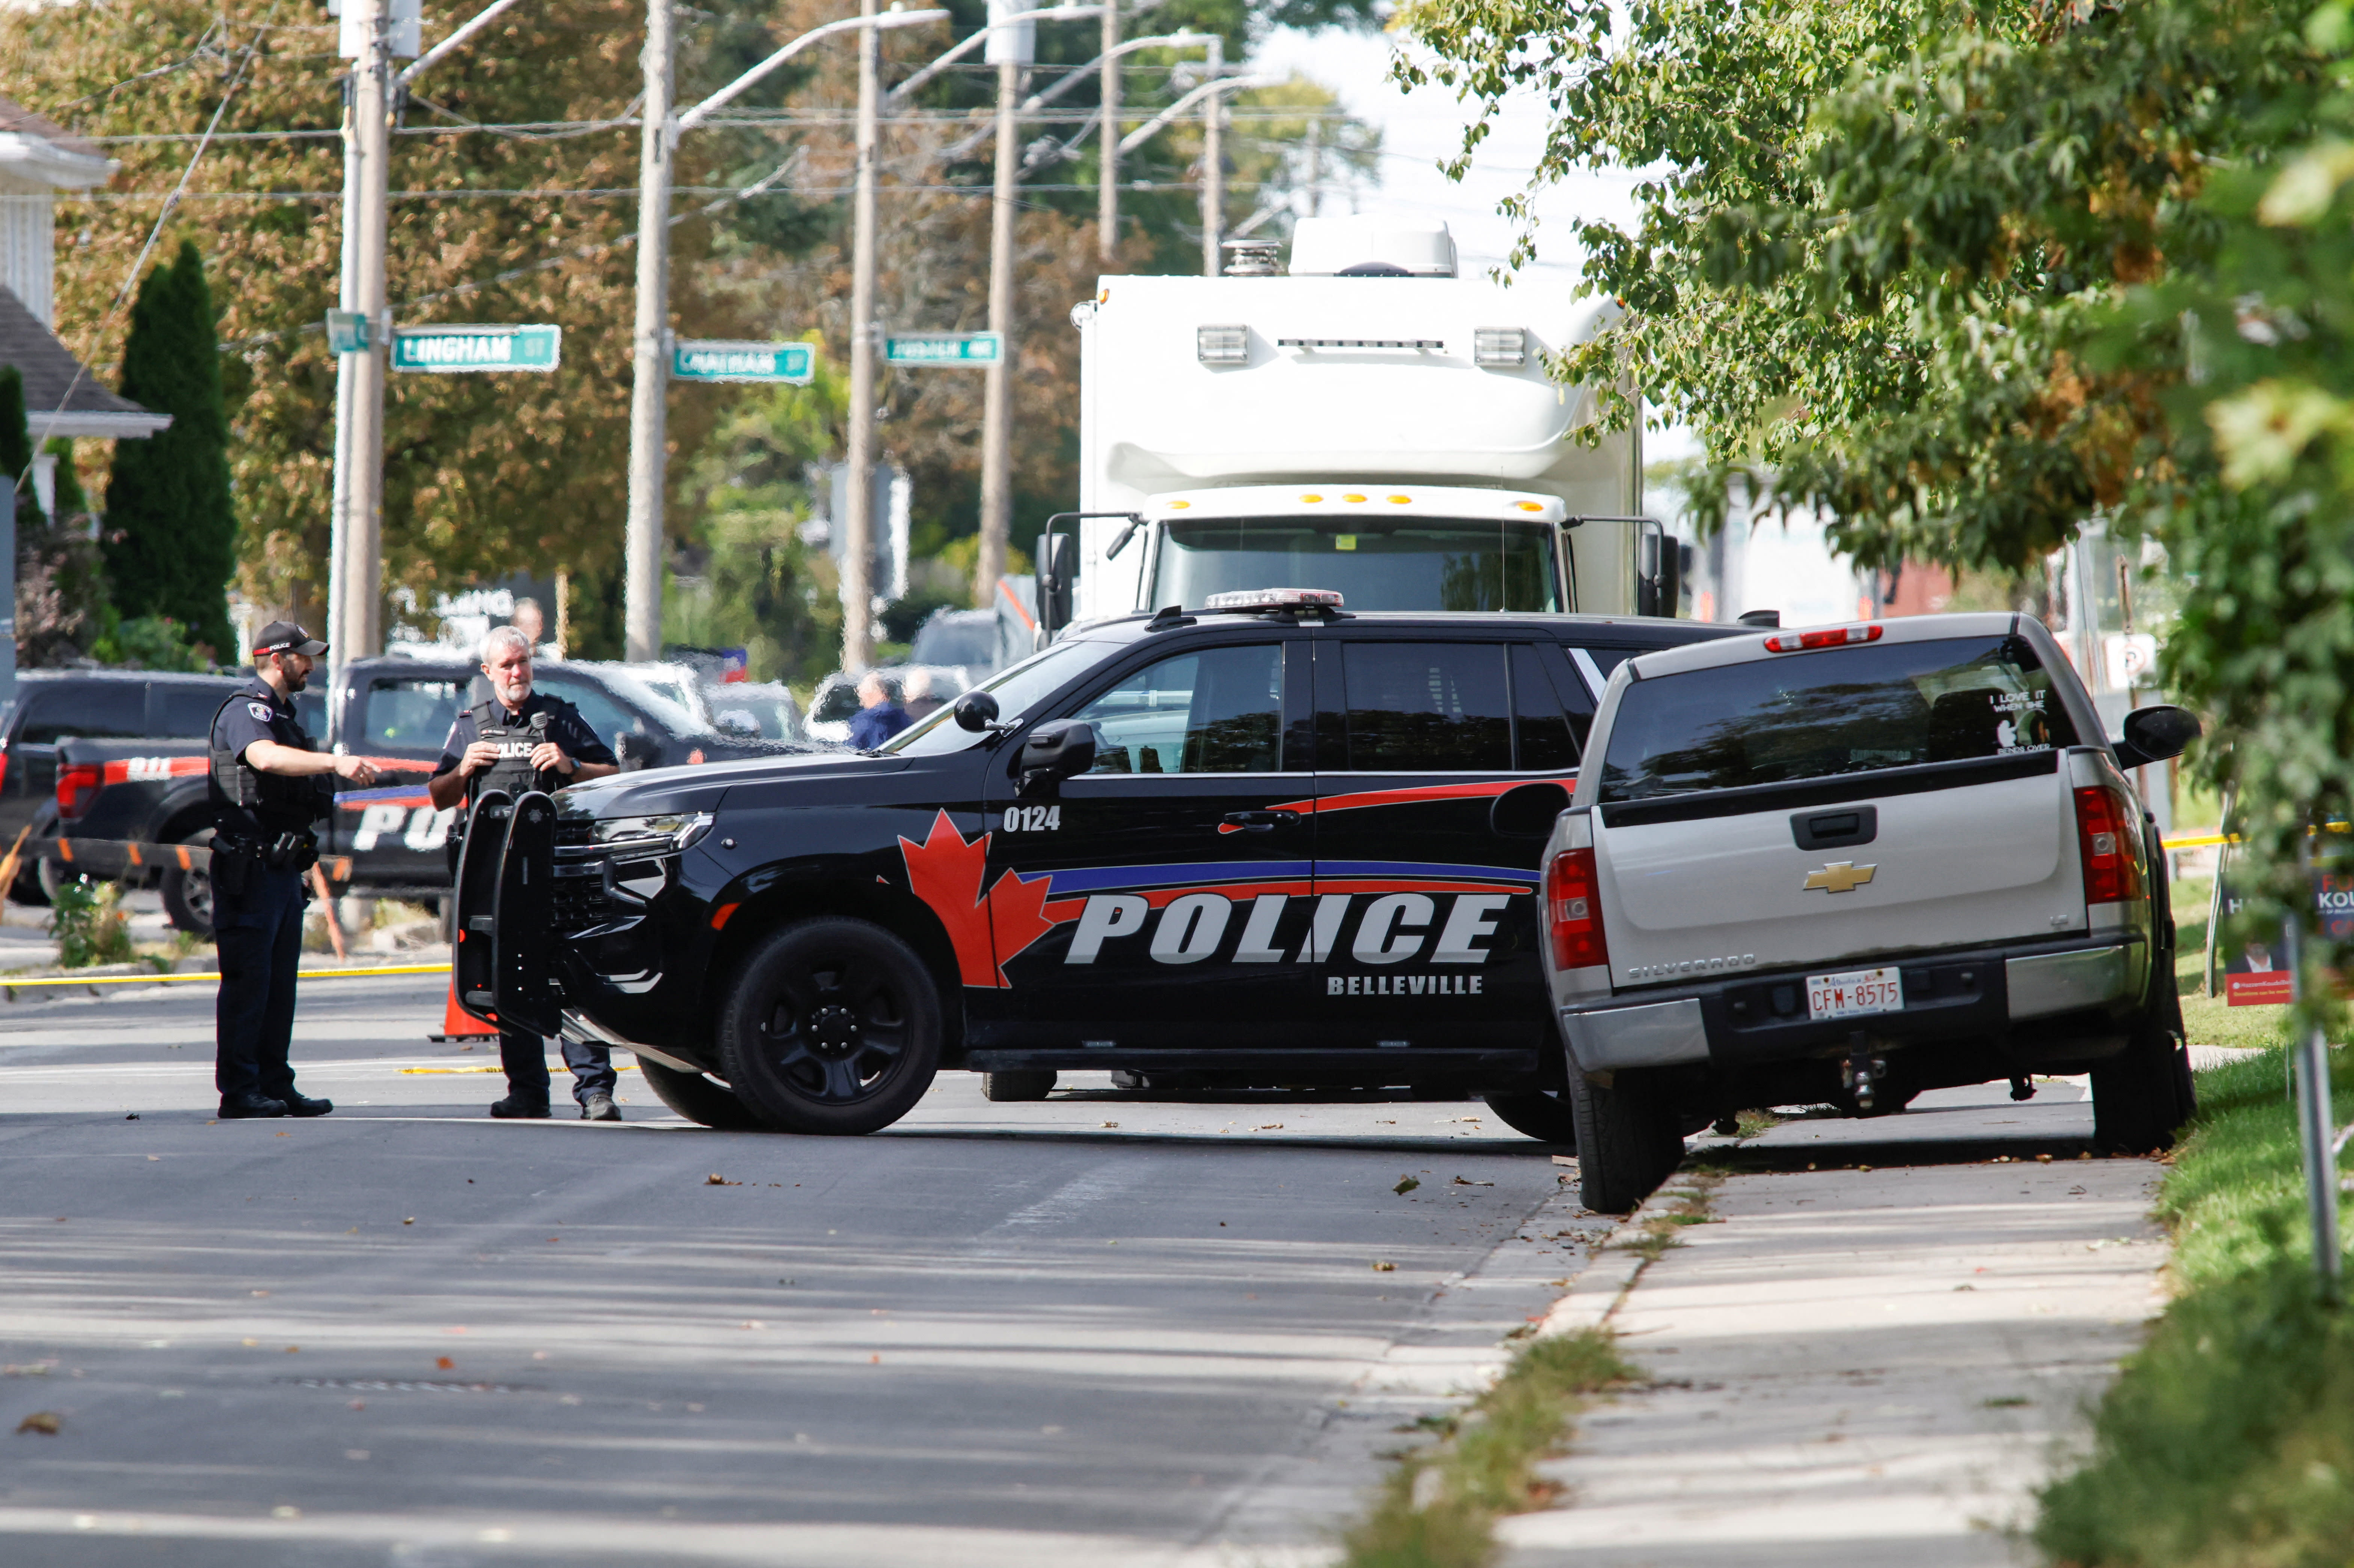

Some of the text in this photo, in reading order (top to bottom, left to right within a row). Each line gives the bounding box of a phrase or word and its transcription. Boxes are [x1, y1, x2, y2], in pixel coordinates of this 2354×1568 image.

[403, 336, 511, 362] LINGHAM
[269, 642, 291, 651] POLICE
[1989, 690, 2046, 704] I LOVE IT
[1993, 703, 2023, 712] WHEN
[497, 742, 533, 758] OLICE
[1003, 805, 1060, 832] 0124
[1064, 893, 1510, 964] POLICE
[1628, 954, 1755, 979] SILVERADO
[1327, 975, 1482, 995] BELLEVILLE
[1812, 982, 1899, 1010] CFM-8575
